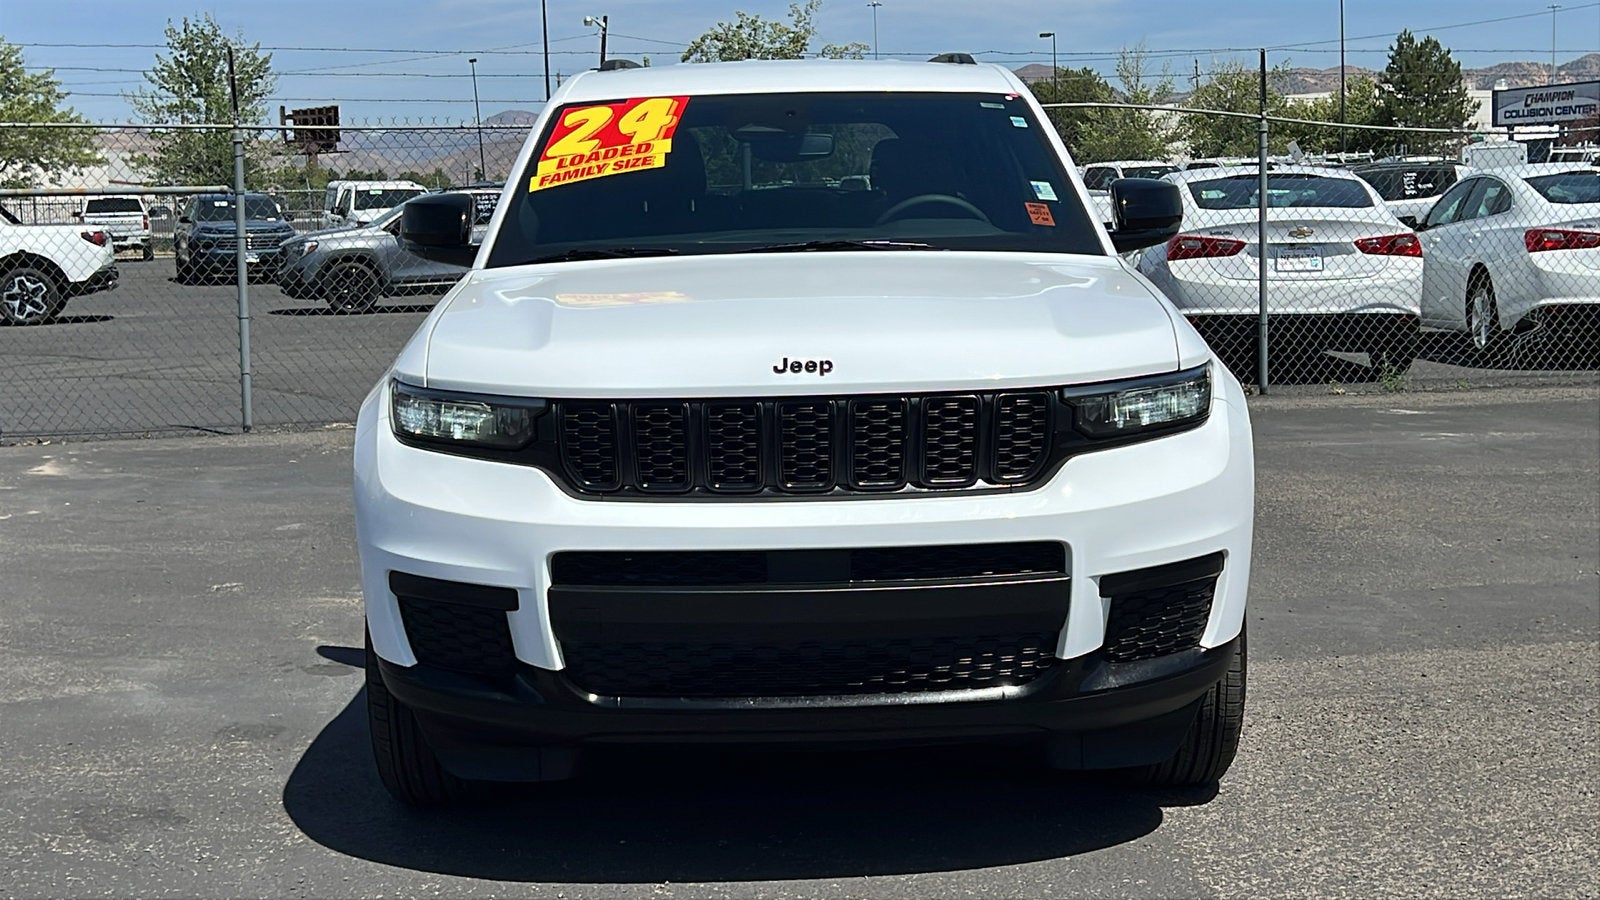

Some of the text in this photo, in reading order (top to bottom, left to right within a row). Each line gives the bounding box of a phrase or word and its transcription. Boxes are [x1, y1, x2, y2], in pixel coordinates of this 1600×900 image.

[1524, 90, 1575, 107] CHAMPION
[1504, 104, 1596, 119] COLLISION CENTER
[546, 98, 678, 158] 24
[556, 142, 654, 170] LOADED
[538, 156, 655, 188] FAMILY SIZE
[772, 357, 834, 377] Jeep
